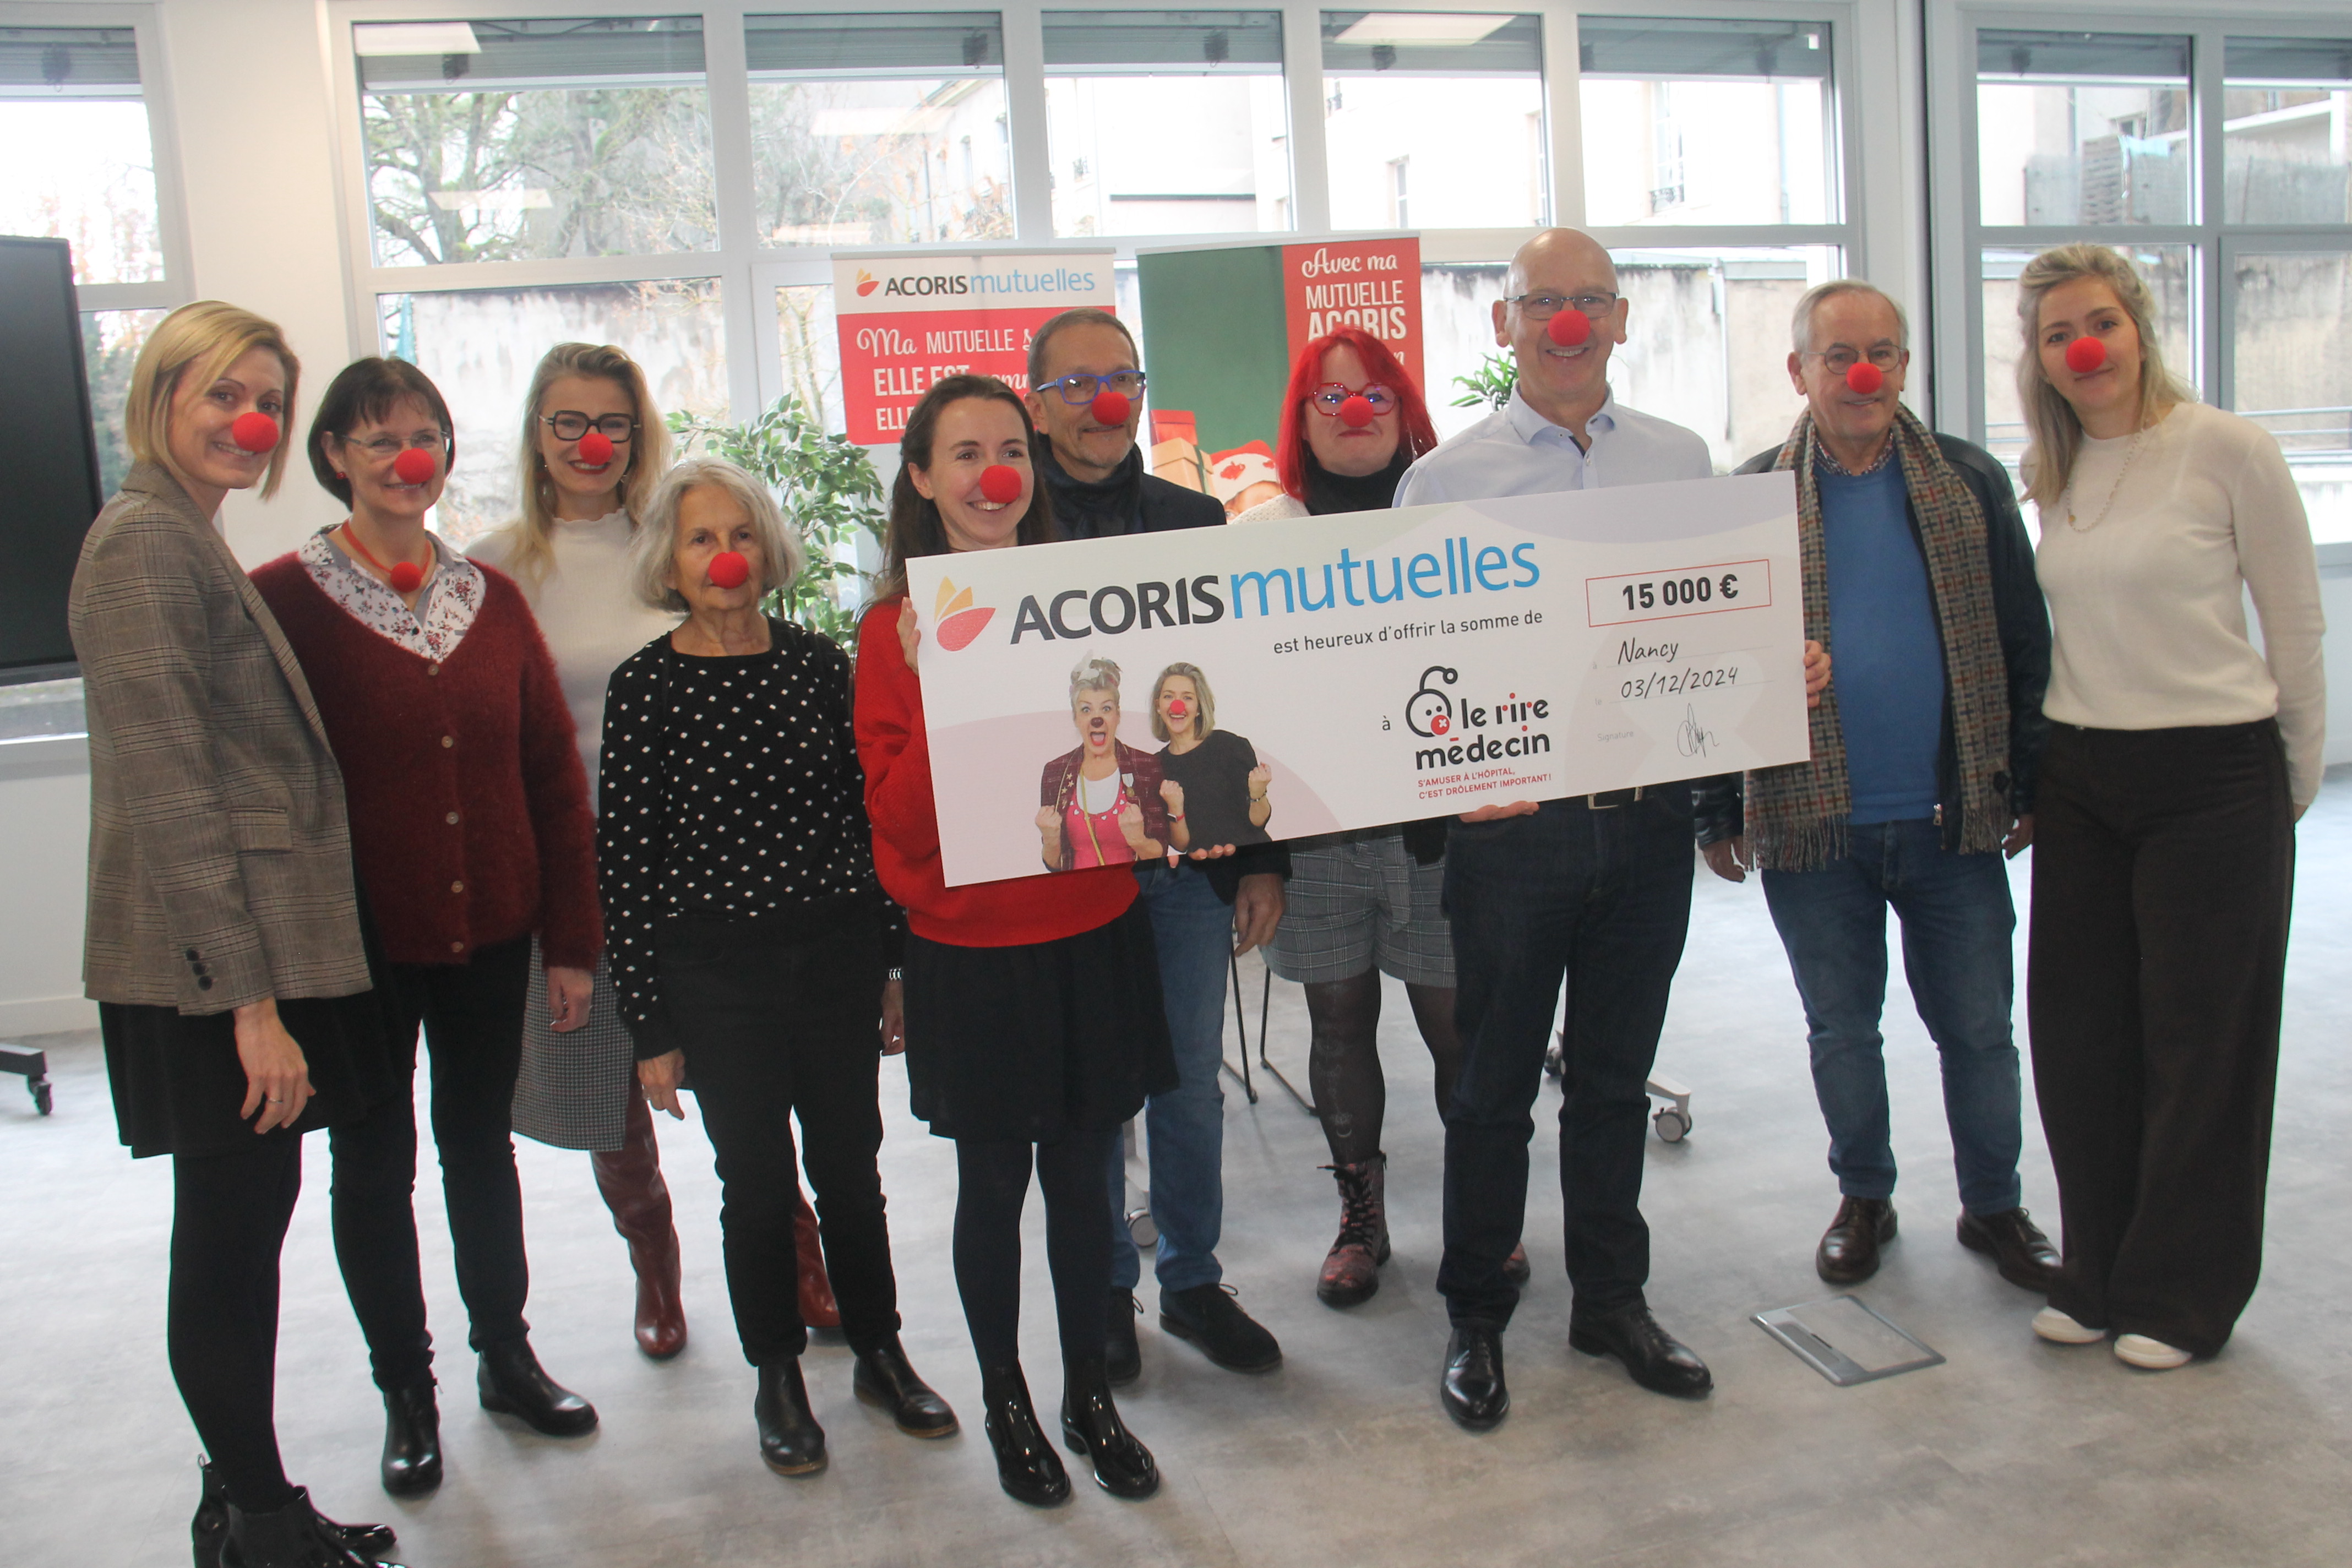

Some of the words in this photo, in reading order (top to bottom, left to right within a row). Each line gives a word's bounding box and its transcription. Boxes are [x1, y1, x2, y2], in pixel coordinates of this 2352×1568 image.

[1302, 247, 1362, 278] Avec
[1367, 254, 1398, 270] ma
[1305, 280, 1404, 309] MUTUELLE
[856, 328, 917, 357] Ma
[926, 329, 1015, 354] MUTUELLE
[873, 367, 925, 396] ELLE
[1623, 582, 1654, 611] 15
[1663, 576, 1711, 606] 000
[1719, 574, 1739, 599] €
[1273, 638, 1299, 654] est
[1304, 630, 1373, 650] heureux
[1378, 622, 1436, 642] d'offrir
[1440, 620, 1456, 635] la
[1460, 614, 1519, 632] somme
[1524, 609, 1543, 624] de
[1618, 637, 1679, 665] Nancy
[1621, 667, 1738, 699] 03/12/2024
[1382, 715, 1391, 731] à
[1461, 698, 1487, 729] le
[1496, 692, 1549, 725] rire
[1597, 731, 1634, 743] Signature
[1418, 775, 1461, 787] S'AMUSER
[1463, 771, 1469, 781] À
[1472, 767, 1515, 780] L'HÔPITAL,
[1419, 790, 1442, 799] C'EST
[1446, 781, 1497, 796] DRÔLEMENT
